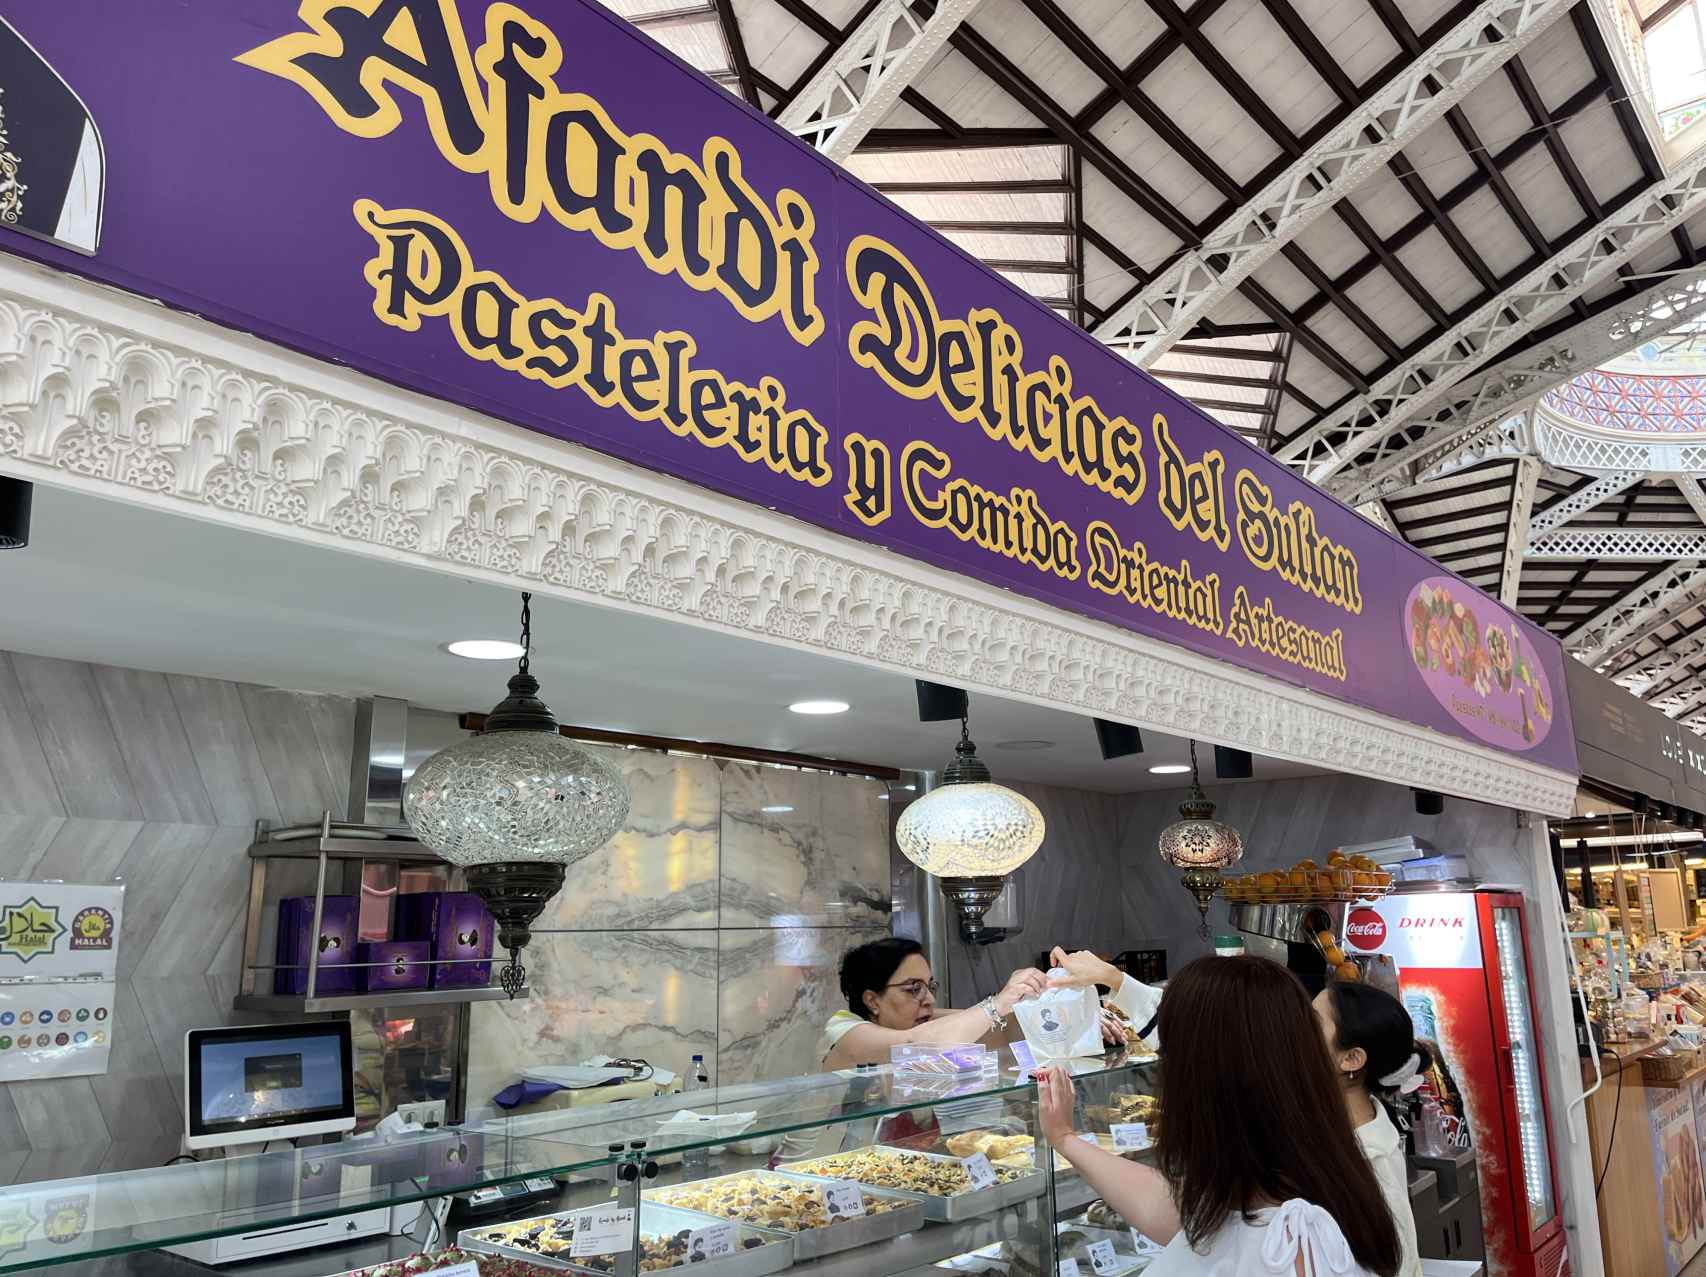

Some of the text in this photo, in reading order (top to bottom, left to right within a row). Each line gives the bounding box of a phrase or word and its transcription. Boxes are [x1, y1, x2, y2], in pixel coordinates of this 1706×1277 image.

[233, 0, 1363, 615] Afandi Delicias del Sultan
[353, 199, 1347, 682] Pasteleria y Comida Oriental Artesanal
[74, 938, 109, 946] HALAL
[1398, 917, 1465, 929] DRINK
